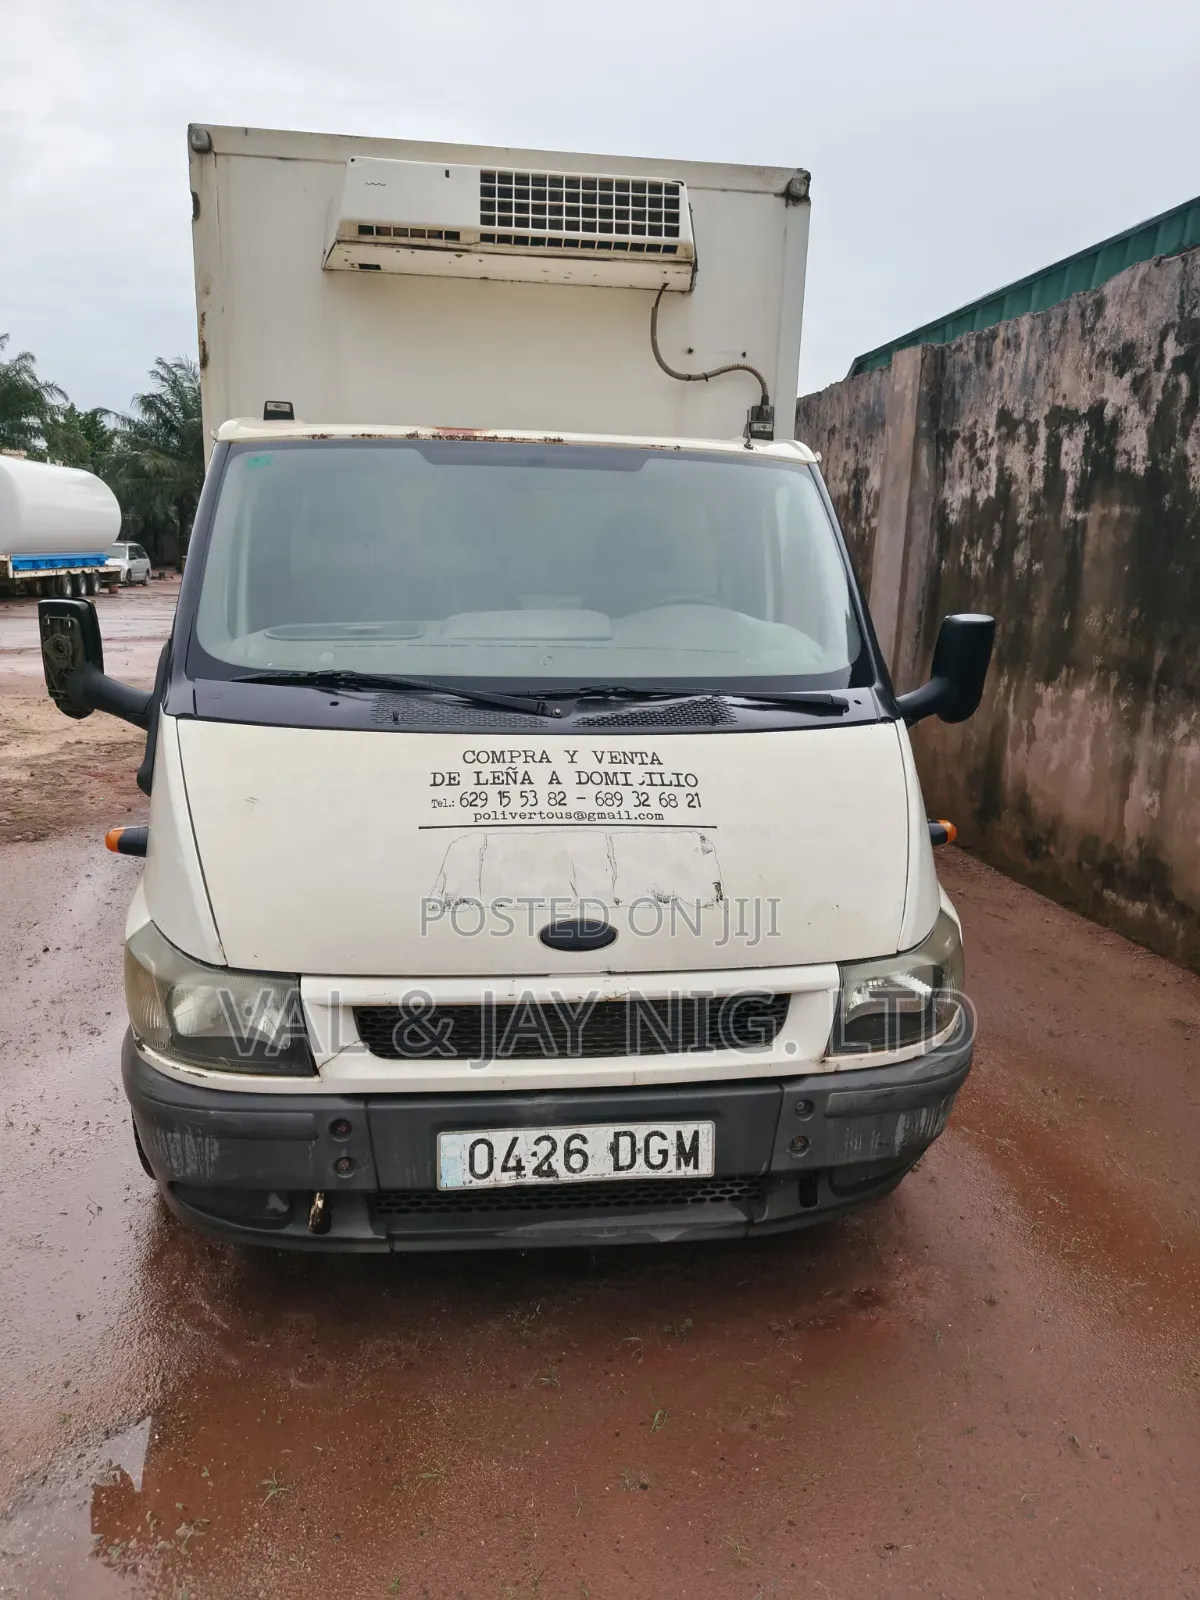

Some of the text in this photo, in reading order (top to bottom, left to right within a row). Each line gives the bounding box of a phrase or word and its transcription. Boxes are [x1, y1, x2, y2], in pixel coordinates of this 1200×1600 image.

[462, 749, 664, 766] COMPRA Y VENTA
[429, 771, 461, 787] DE
[473, 766, 535, 786] LEÑA
[548, 770, 563, 785] A
[431, 798, 455, 809] Tel.:
[459, 791, 488, 808] 629
[497, 790, 512, 808] 15
[519, 790, 538, 808] 53
[547, 790, 568, 807] 82
[595, 791, 624, 808] 689
[631, 790, 651, 808] 32
[658, 792, 679, 808] 68
[685, 792, 702, 809] 21
[473, 810, 665, 823] polivertous@gmail.com
[468, 1130, 699, 1180] 0426 DGM
